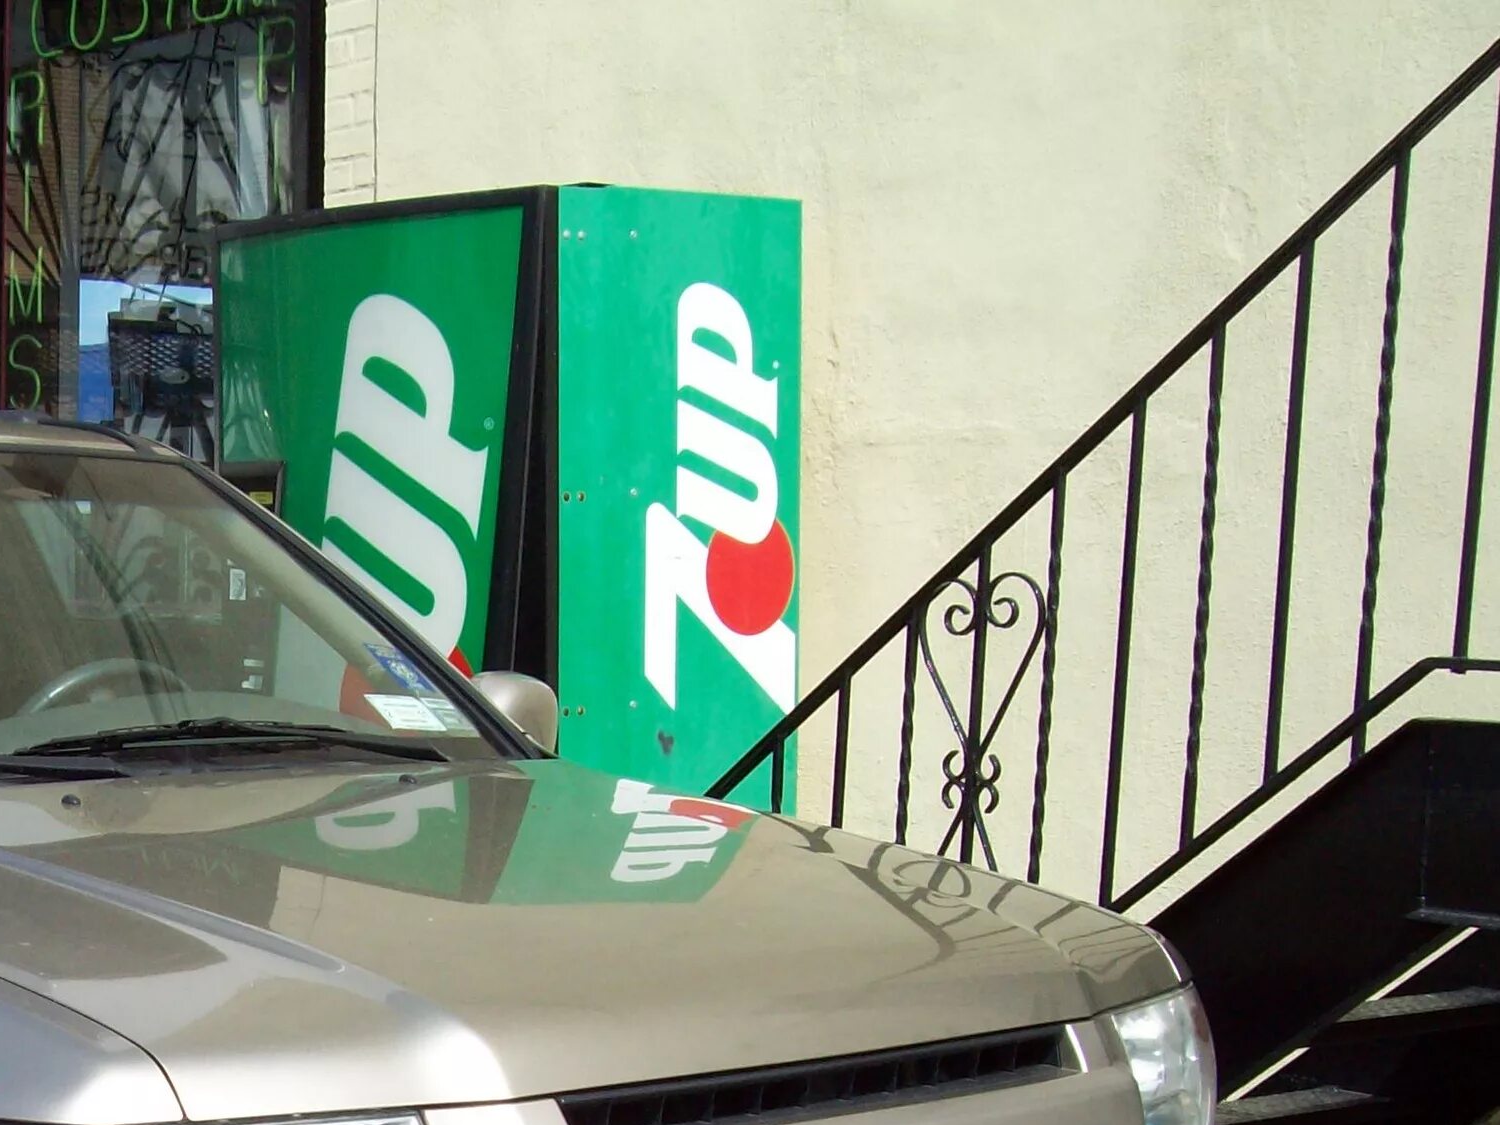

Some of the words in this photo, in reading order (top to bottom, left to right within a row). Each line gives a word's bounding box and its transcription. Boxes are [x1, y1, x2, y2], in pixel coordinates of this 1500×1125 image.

[31, 0, 277, 57] CUS
[9, 71, 46, 407] RIMS
[321, 293, 489, 658] UP
[645, 281, 796, 716] 7UP
